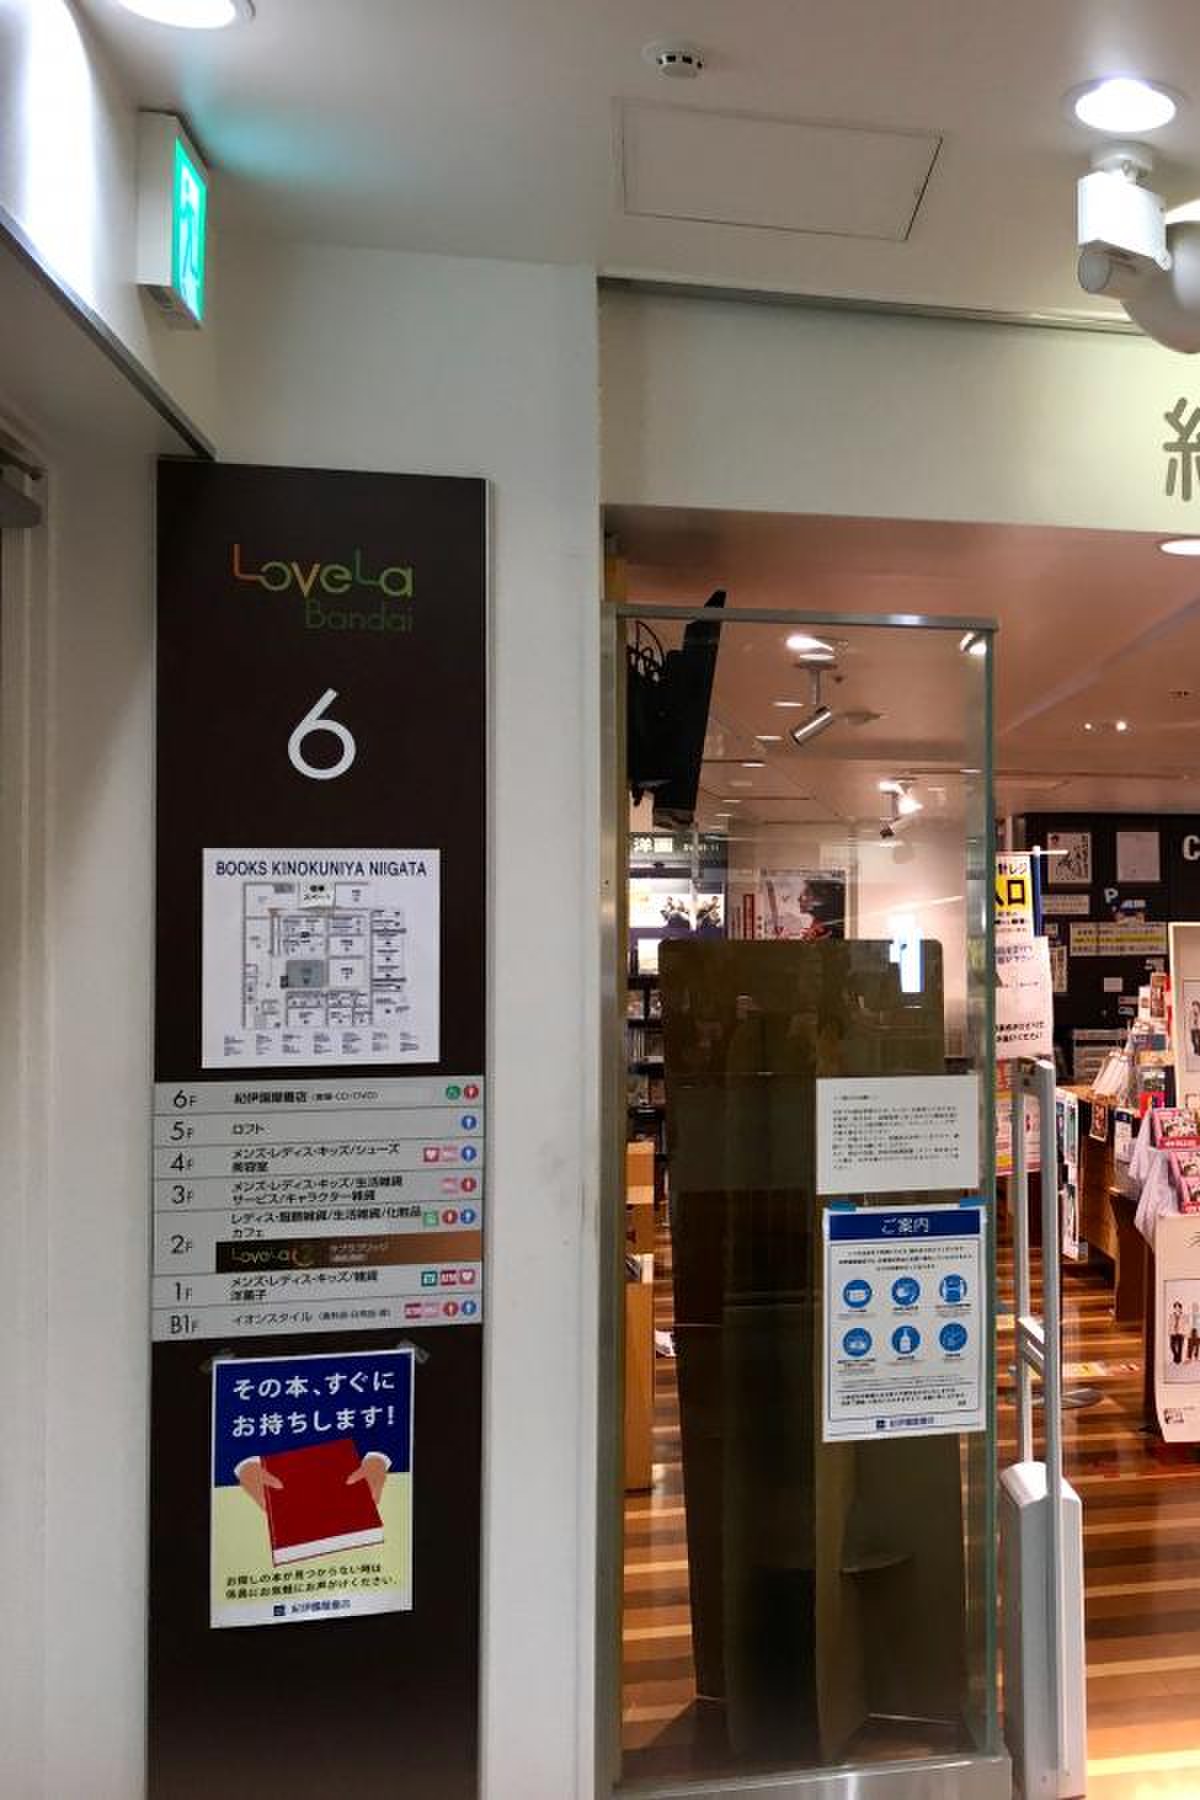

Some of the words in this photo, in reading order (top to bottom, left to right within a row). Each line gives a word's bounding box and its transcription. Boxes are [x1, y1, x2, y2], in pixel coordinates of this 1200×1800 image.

[230, 543, 415, 598] LoveLa
[304, 600, 414, 633] Bandai
[287, 687, 357, 780] 6
[215, 860, 267, 876] BOOKS
[271, 860, 366, 876] KINOKUNIYA
[369, 860, 428, 876] NIIGATA
[172, 1089, 198, 1110] 6F
[169, 1121, 194, 1141] 5F
[232, 1122, 265, 1136] ロフト
[169, 1152, 193, 1172] 4F
[171, 1184, 193, 1205] 3F
[881, 1216, 929, 1234] ご案内
[170, 1234, 193, 1255] 2F
[174, 1282, 193, 1301] 1F
[169, 1314, 199, 1334] B1F
[232, 1311, 312, 1326] イオンスタイル
[232, 1371, 396, 1401] その本、すぐに
[231, 1405, 396, 1437] お持ちします！
